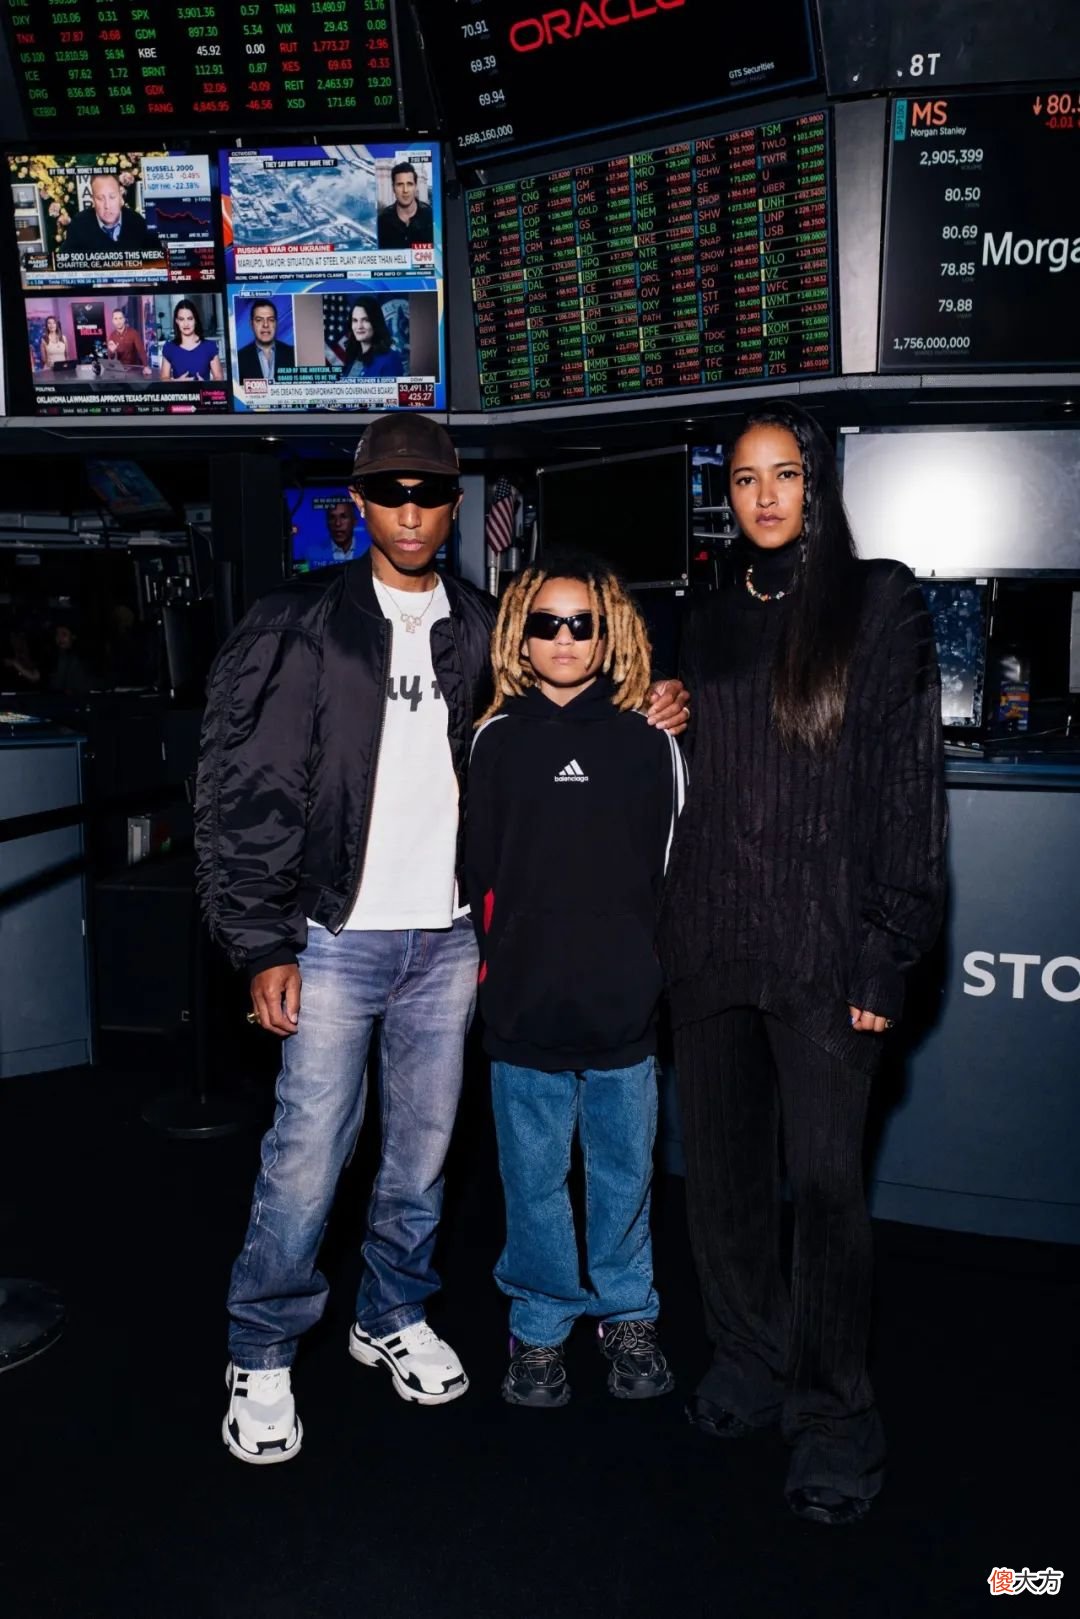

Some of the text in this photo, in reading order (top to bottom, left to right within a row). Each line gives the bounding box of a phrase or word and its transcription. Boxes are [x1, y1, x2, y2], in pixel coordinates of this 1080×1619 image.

[131, 5, 259, 20] SPX 3,901.36 0.57
[274, 4, 296, 14] TRAN
[12, 15, 30, 26] DXY
[98, 11, 118, 22] 0.31
[135, 24, 262, 39] GDM 897.30 5.34
[277, 20, 386, 33] VIX 29.43 0.08
[461, 20, 489, 38] 70.91
[139, 44, 266, 58] KBE 45.92 0.00
[142, 62, 268, 77] BRNT 112.91 0.87
[470, 55, 497, 73] 69.39
[729, 67, 742, 79] GTS
[743, 60, 775, 77] Securities
[25, 71, 40, 81] ICE
[110, 68, 128, 78] 1.72
[285, 80, 304, 91] REIT
[368, 77, 391, 87] 19.20
[108, 86, 132, 97] 16.04
[478, 89, 505, 106] 69.94
[287, 99, 305, 109] XSD
[374, 96, 392, 106] 0.07
[1047, 94, 1080, 114] 80.
[912, 101, 948, 127] MS
[458, 124, 514, 148] 2,668,160,000
[762, 124, 781, 136] TSM
[910, 126, 967, 138] Morgan Stanley
[696, 138, 715, 150] PNC
[762, 138, 786, 150] TWLO
[762, 152, 787, 164] TWTR
[919, 148, 984, 166] 2,905,399
[146, 164, 194, 173] RUSSELL 2000
[635, 166, 655, 178] MRO
[697, 166, 720, 178] SCHW
[576, 180, 590, 190] GM
[636, 181, 648, 191] MS
[698, 183, 708, 193] SE
[763, 182, 785, 193] UBER
[578, 192, 596, 204] GME
[944, 187, 981, 202] 80.50
[578, 205, 598, 216] GOLD
[637, 207, 656, 218] NEM
[699, 208, 720, 220] SHW
[764, 211, 784, 223] UNP
[700, 223, 716, 234] SLB
[765, 225, 784, 236] USB
[942, 225, 978, 240] 80.69
[237, 246, 269, 254] RUSSIA'S
[269, 245, 287, 253] WAR
[300, 244, 331, 252] UKRAINE
[56, 253, 70, 262] S&P
[71, 252, 84, 261] 500
[86, 251, 123, 261] LAGGARDS
[124, 251, 140, 260] THIS
[414, 251, 433, 262] CNN
[766, 253, 784, 264] VLO
[640, 260, 658, 271] OKE
[940, 262, 975, 277] 78.85
[641, 287, 660, 297] OVV
[767, 281, 788, 292] WFC
[642, 300, 660, 310] OXY
[938, 299, 973, 313] 79.88
[893, 336, 971, 351] 1,756,000,000
[769, 350, 785, 360] ZIM
[706, 358, 722, 368] TFC
[770, 364, 786, 374] ZTS
[400, 384, 433, 392] 33,491.12
[101, 394, 125, 403] APPROVE
[161, 393, 188, 402] ABORTION
[963, 950, 1080, 1002] STO
